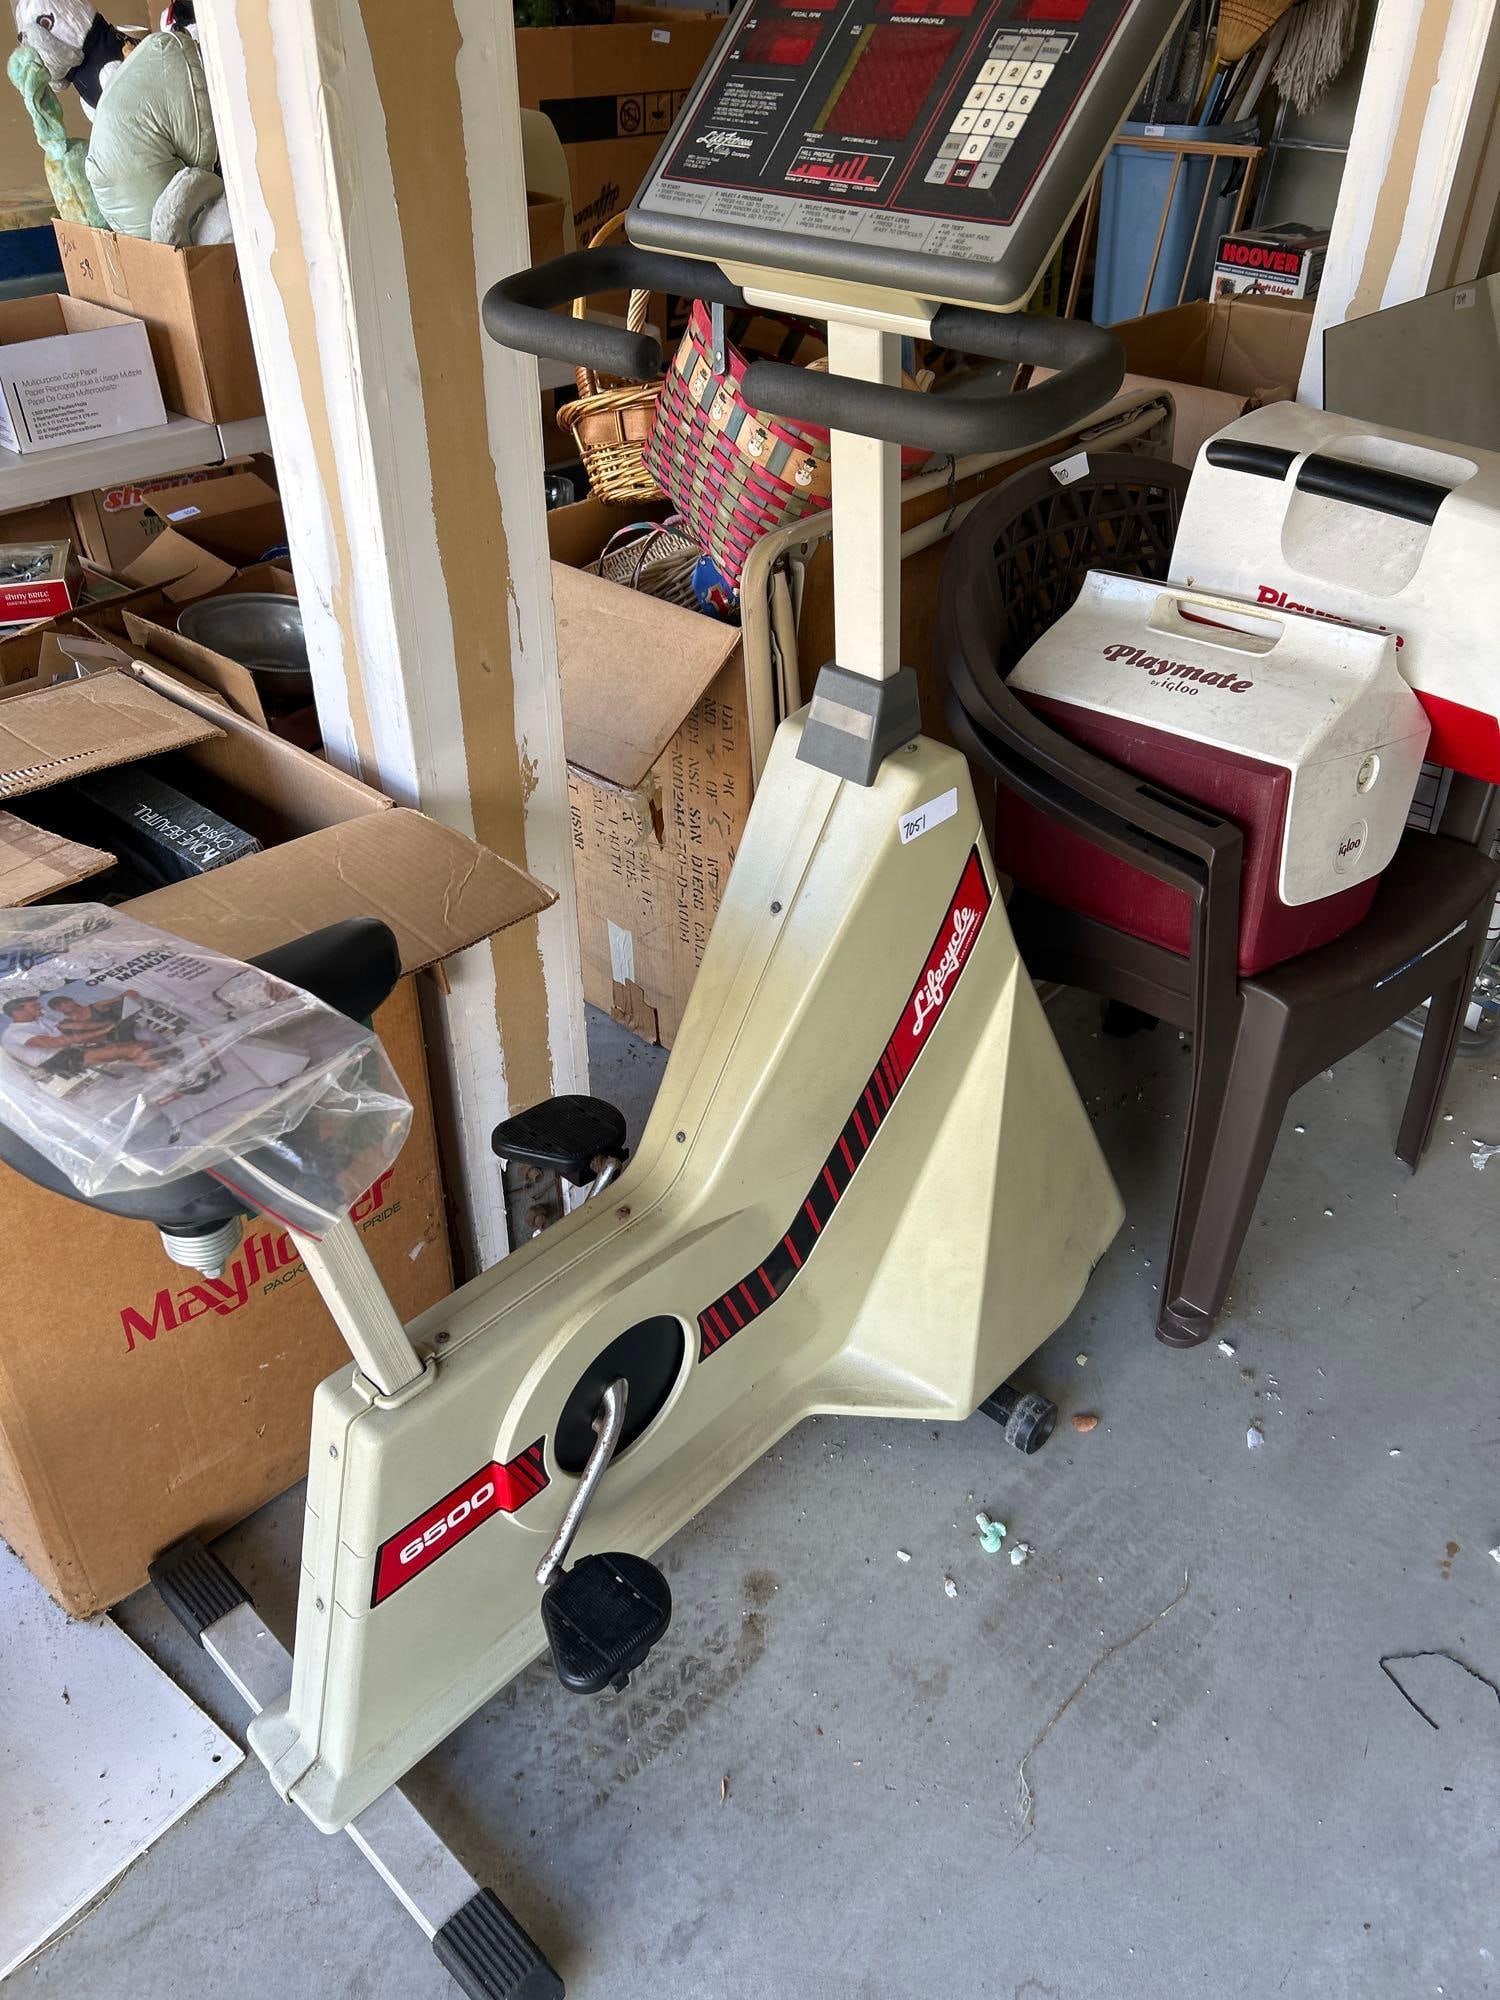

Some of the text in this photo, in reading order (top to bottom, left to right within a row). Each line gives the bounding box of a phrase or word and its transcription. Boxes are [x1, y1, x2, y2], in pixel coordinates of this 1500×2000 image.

[890, 16, 945, 25] PROGRAM PROFILE
[1019, 28, 1056, 36] PROGRAMS
[988, 66, 1043, 80] 1 2 3
[975, 91, 1029, 105] 4 5 6
[960, 116, 1015, 131] 7 8 9
[800, 149, 813, 157] HILL
[813, 150, 836, 159] PROFILE
[969, 144, 978, 154] 0
[954, 169, 970, 178] START
[59, 232, 77, 258] Box
[79, 258, 94, 280] 58
[1222, 243, 1299, 273] HOOVER
[21, 368, 99, 388] Multipurpose Copy Paper
[24, 387, 45, 398] Papier
[45, 378, 95, 394] Reprographique
[99, 374, 119, 384] Usage
[120, 368, 143, 378] Multiple
[27, 396, 45, 407] Papel
[45, 395, 56, 403] De
[57, 391, 76, 402] Copia
[1103, 644, 1253, 693] Playmate
[1160, 677, 1199, 696] igloo
[688, 757, 700, 795] NSC
[134, 804, 186, 840] BEAUTIFUL
[690, 806, 702, 845] SAN
[904, 814, 926, 839] 7051
[191, 823, 234, 850] Crystal
[1338, 838, 1361, 857] igloo
[691, 854, 704, 912] DIEGO
[115, 951, 180, 982] MANUAL
[913, 907, 976, 1036] Lifecycle
[120, 1168, 394, 1353] Mayfloer
[264, 1201, 401, 1295] PACKE PRIDE
[400, 1482, 495, 1564] 6500
